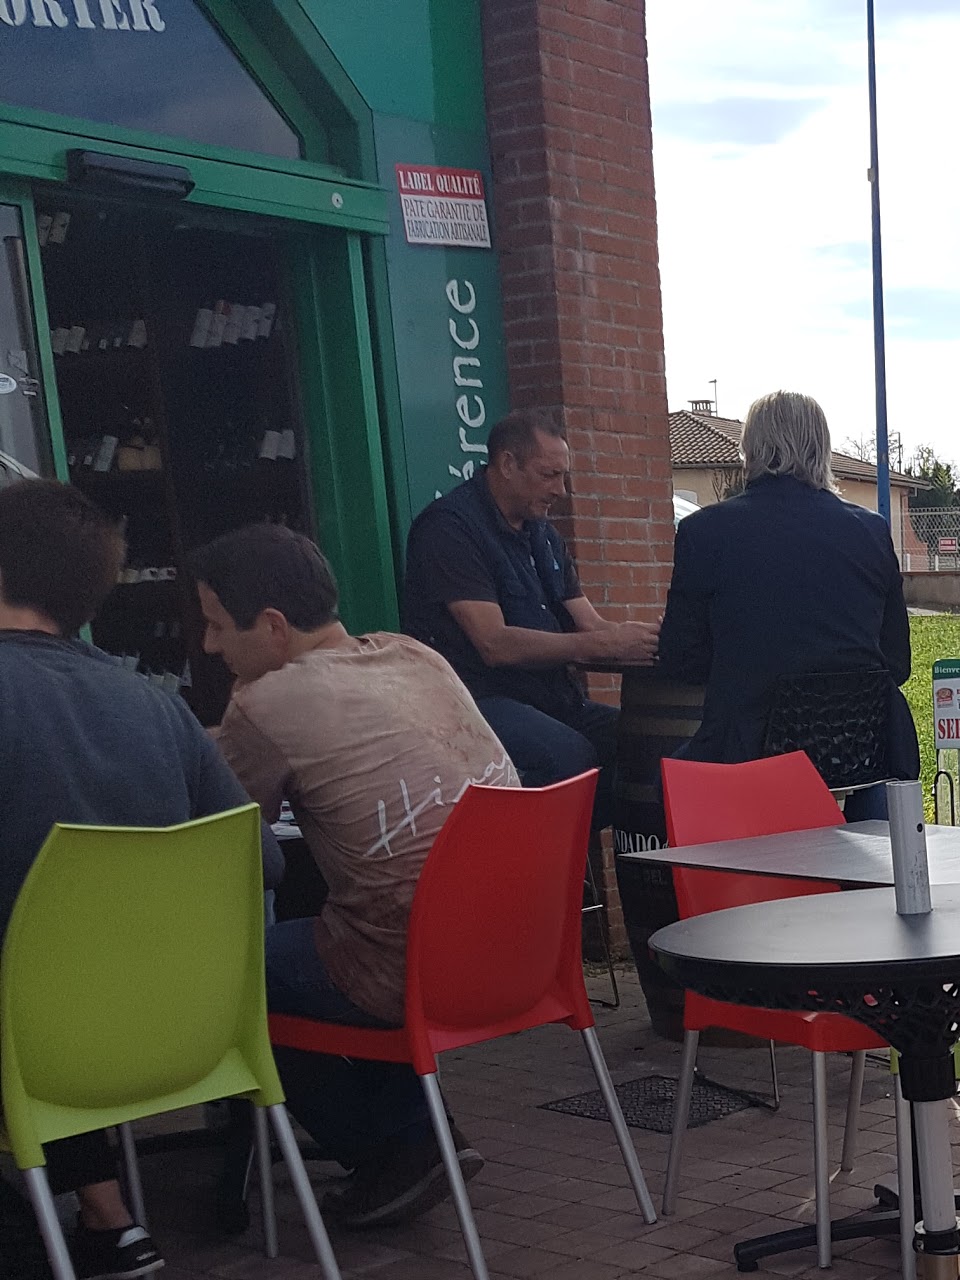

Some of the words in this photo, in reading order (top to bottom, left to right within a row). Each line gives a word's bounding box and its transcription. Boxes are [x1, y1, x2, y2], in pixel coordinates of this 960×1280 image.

[399, 171, 434, 191] LABEL
[436, 174, 481, 195] QUALITÉ
[404, 199, 425, 218] PATE
[427, 201, 472, 221] GARANTIE
[473, 204, 486, 222] DE
[407, 219, 452, 239] FABRICATION
[451, 222, 488, 242] ARTISANALE
[437, 279, 489, 499] érence
